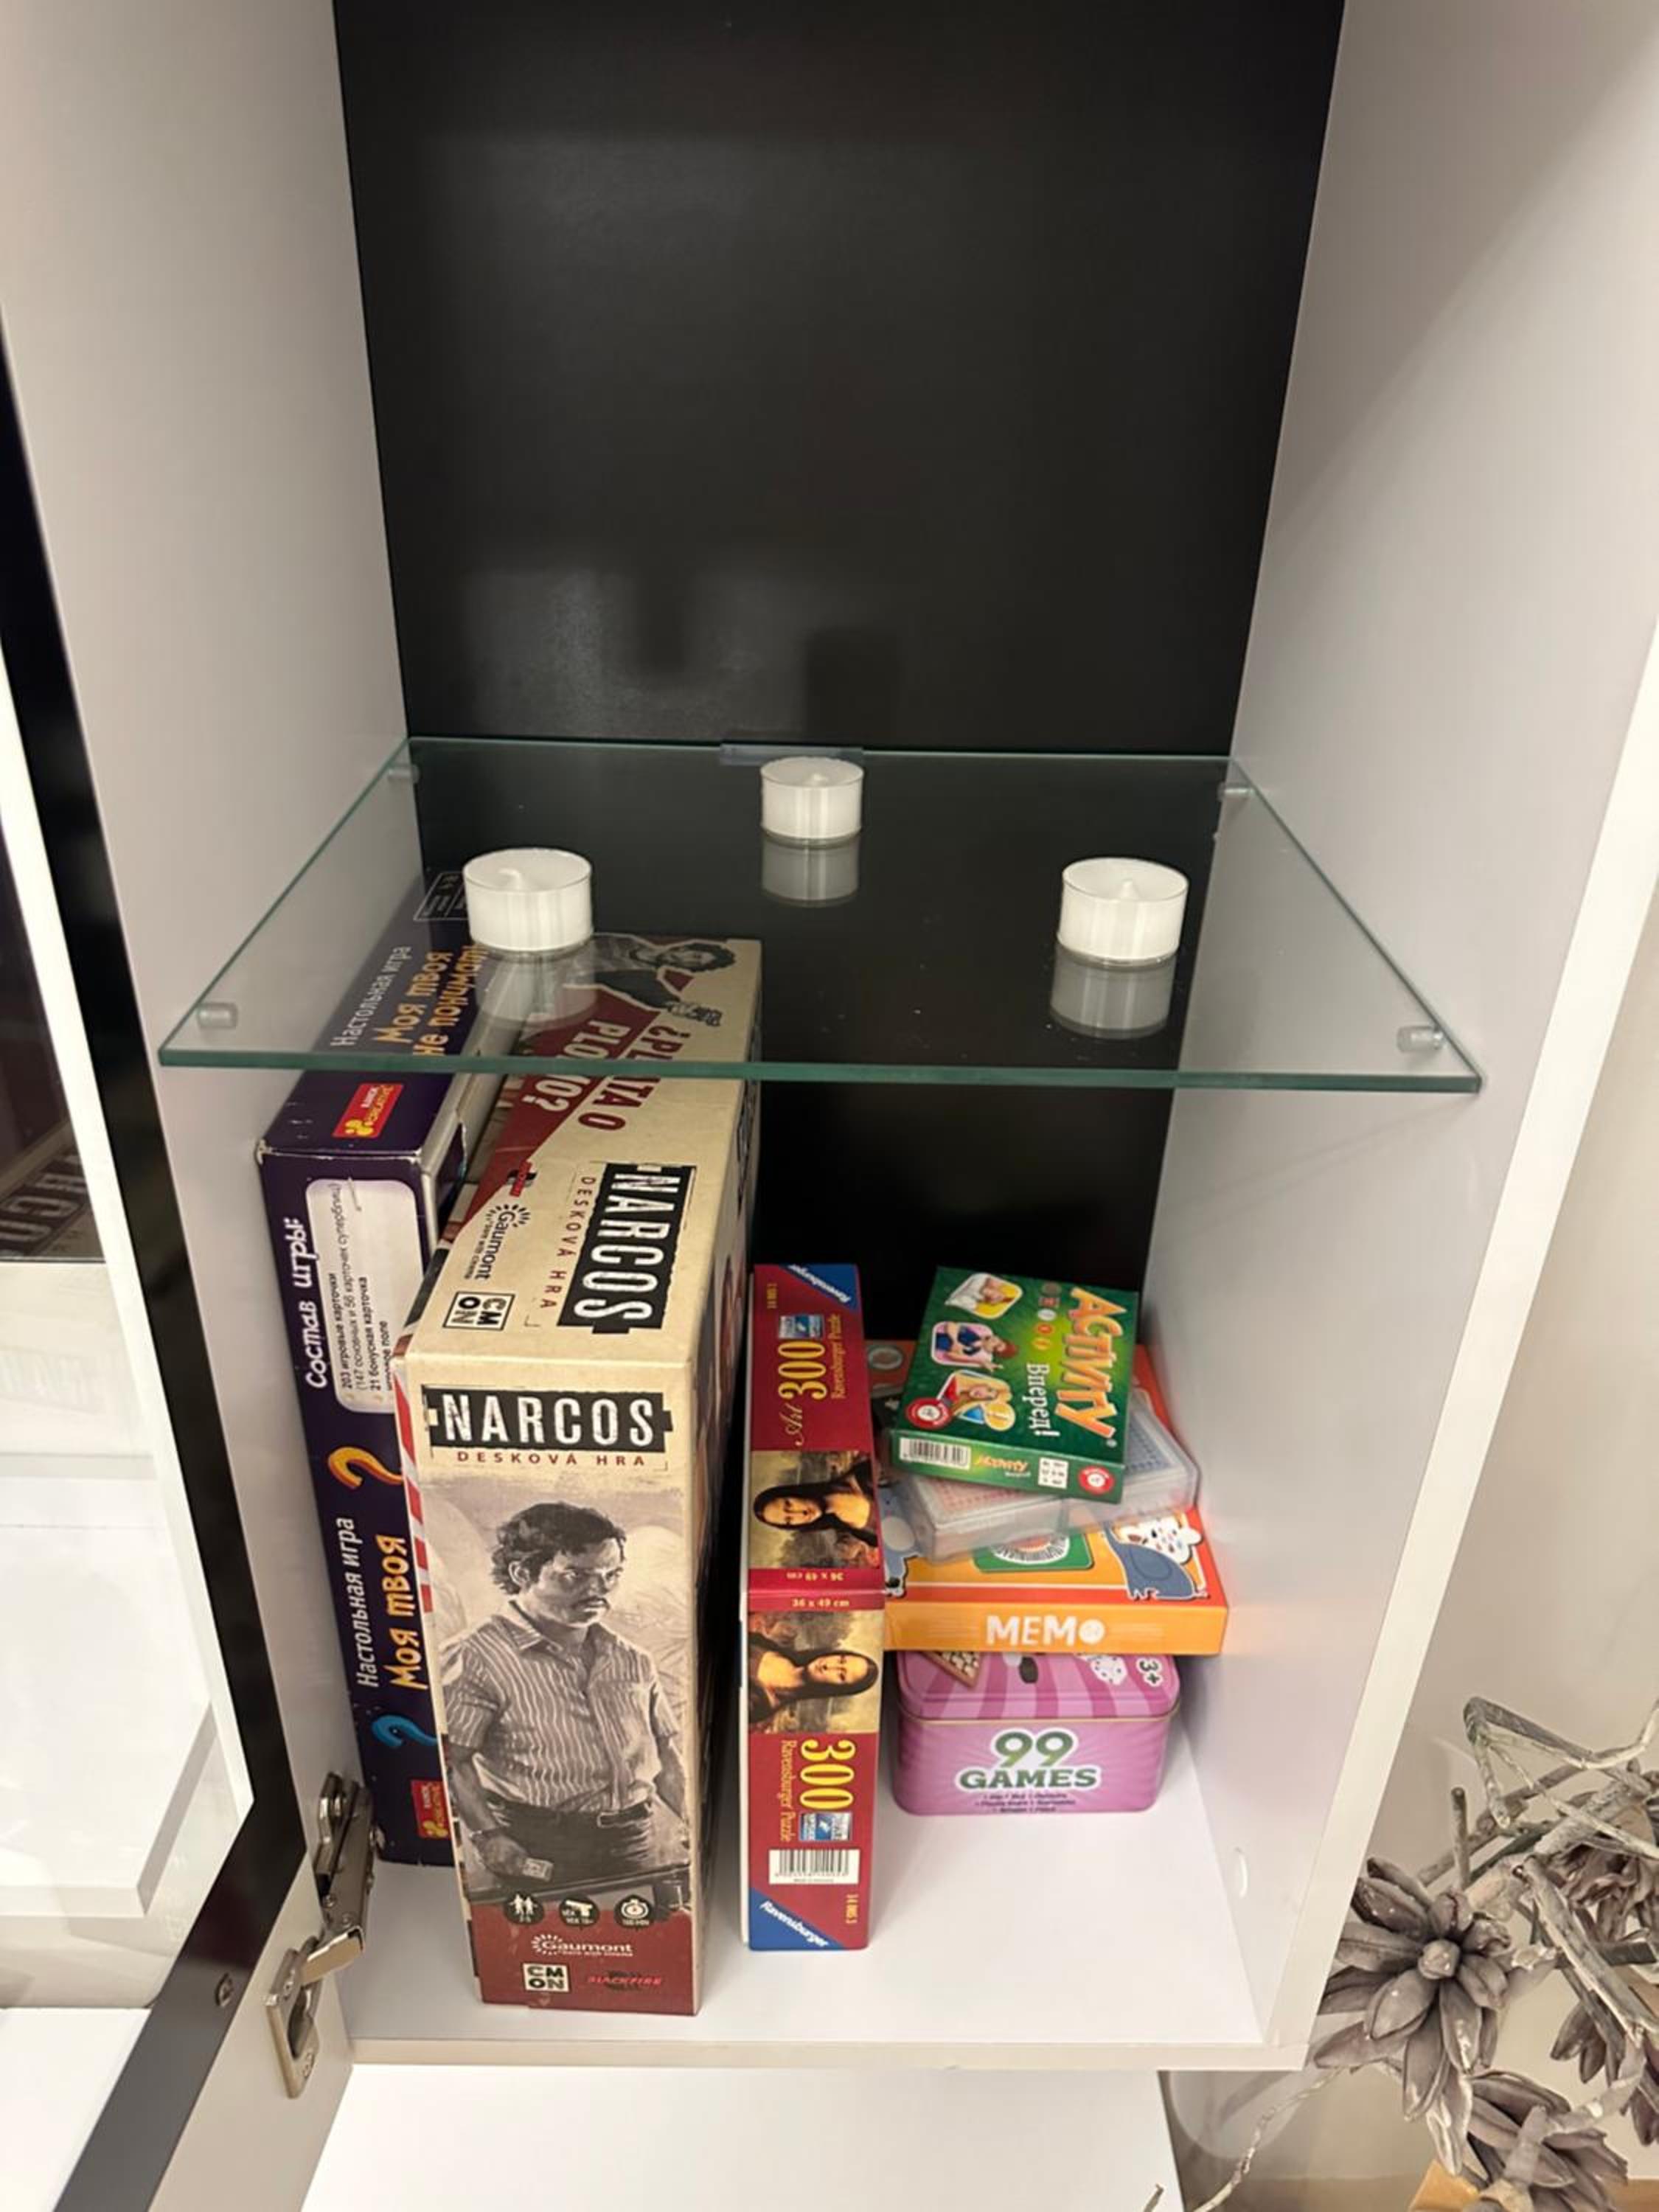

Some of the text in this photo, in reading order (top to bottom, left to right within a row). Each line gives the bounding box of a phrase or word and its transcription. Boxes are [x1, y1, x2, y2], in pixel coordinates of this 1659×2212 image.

[330, 973, 392, 1046] Настольная
[383, 946, 413, 973] игра
[373, 1004, 427, 1044] Моя
[407, 952, 453, 997] твоя
[521, 1020, 630, 1111] PLOO?
[578, 1026, 691, 1131] ¿PLTA O
[475, 1211, 515, 1280] Gaumont
[540, 1176, 597, 1309] DESKOVÁ HRA
[574, 1173, 681, 1320] NARCOS
[340, 1247, 355, 1293] карточек
[282, 1217, 328, 1388] Состав игры:
[329, 1273, 343, 1321] карточки
[358, 1276, 373, 1325] карточка
[451, 1296, 481, 1324] ON
[477, 1297, 507, 1326] CM
[336, 1324, 349, 1369] игровые
[365, 1327, 380, 1377] бонусная
[379, 1321, 390, 1346] поле
[827, 1314, 846, 1399] Ravensburger Puzzle
[778, 1340, 827, 1400] 300
[442, 1394, 654, 1447] NARCOS
[457, 1450, 645, 1467] DESKOVÁ HRA
[336, 1517, 379, 1688] Настольная игра
[376, 1534, 429, 1691] Моя твоя
[833, 1599, 849, 1607] cm
[985, 1615, 1105, 1646] MEMO
[1139, 1660, 1161, 1684] 3+
[994, 1731, 1074, 1767] 99
[777, 1739, 797, 1842] Ravensburger Puzzle
[800, 1739, 856, 1809] 300
[959, 1768, 1097, 1789] GAMES
[541, 1941, 633, 1952] Gaumont
[759, 1899, 829, 1948] Ravensburger
[527, 1966, 565, 1978] CM
[529, 1978, 565, 1989] ON
